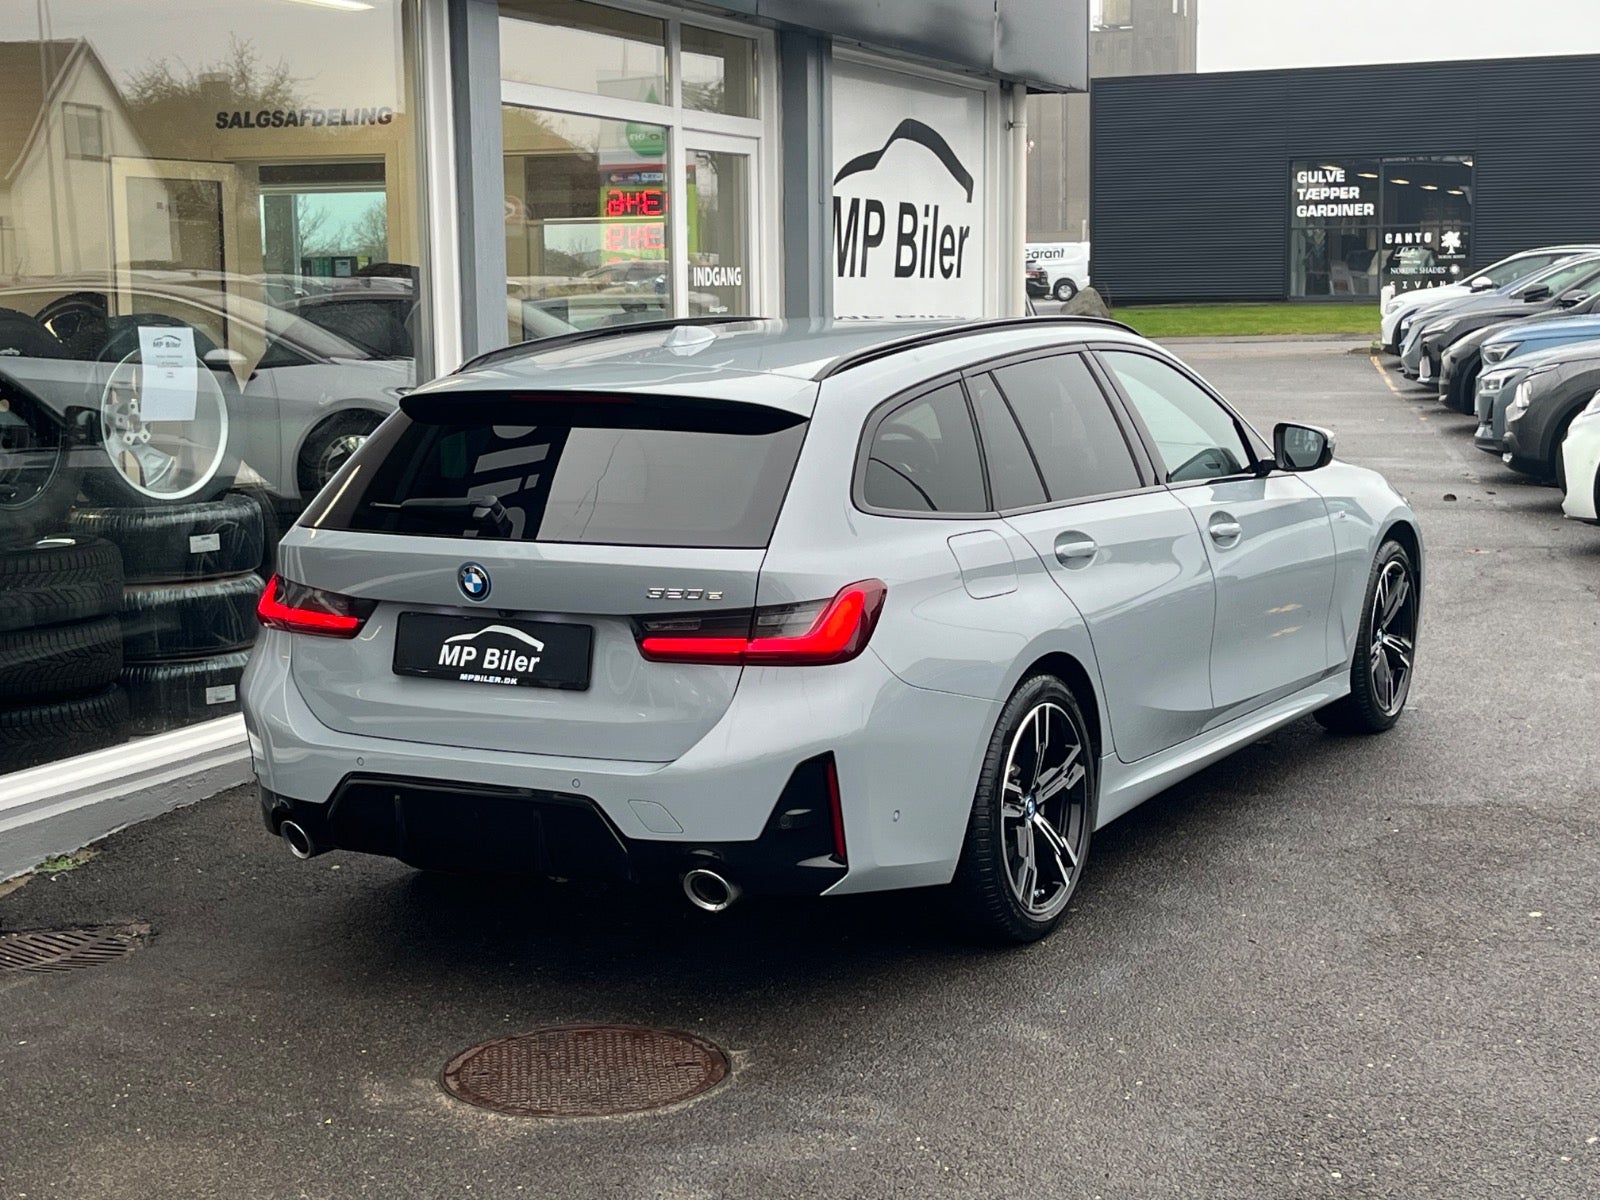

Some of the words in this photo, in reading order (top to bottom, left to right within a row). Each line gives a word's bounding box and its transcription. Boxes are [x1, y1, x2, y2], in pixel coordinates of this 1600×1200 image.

[215, 106, 393, 129] SALGSAFDELING
[1296, 170, 1346, 183] GULVE
[1296, 186, 1360, 201] TÆPPER
[1296, 203, 1375, 218] GARDINER
[832, 195, 886, 278] MP
[894, 201, 971, 280] Biler
[1384, 231, 1433, 244] CANTO
[693, 266, 742, 287] INDGANG
[438, 644, 477, 667] MP
[482, 647, 541, 673] Biler
[459, 673, 518, 685] MPBILER.DK
